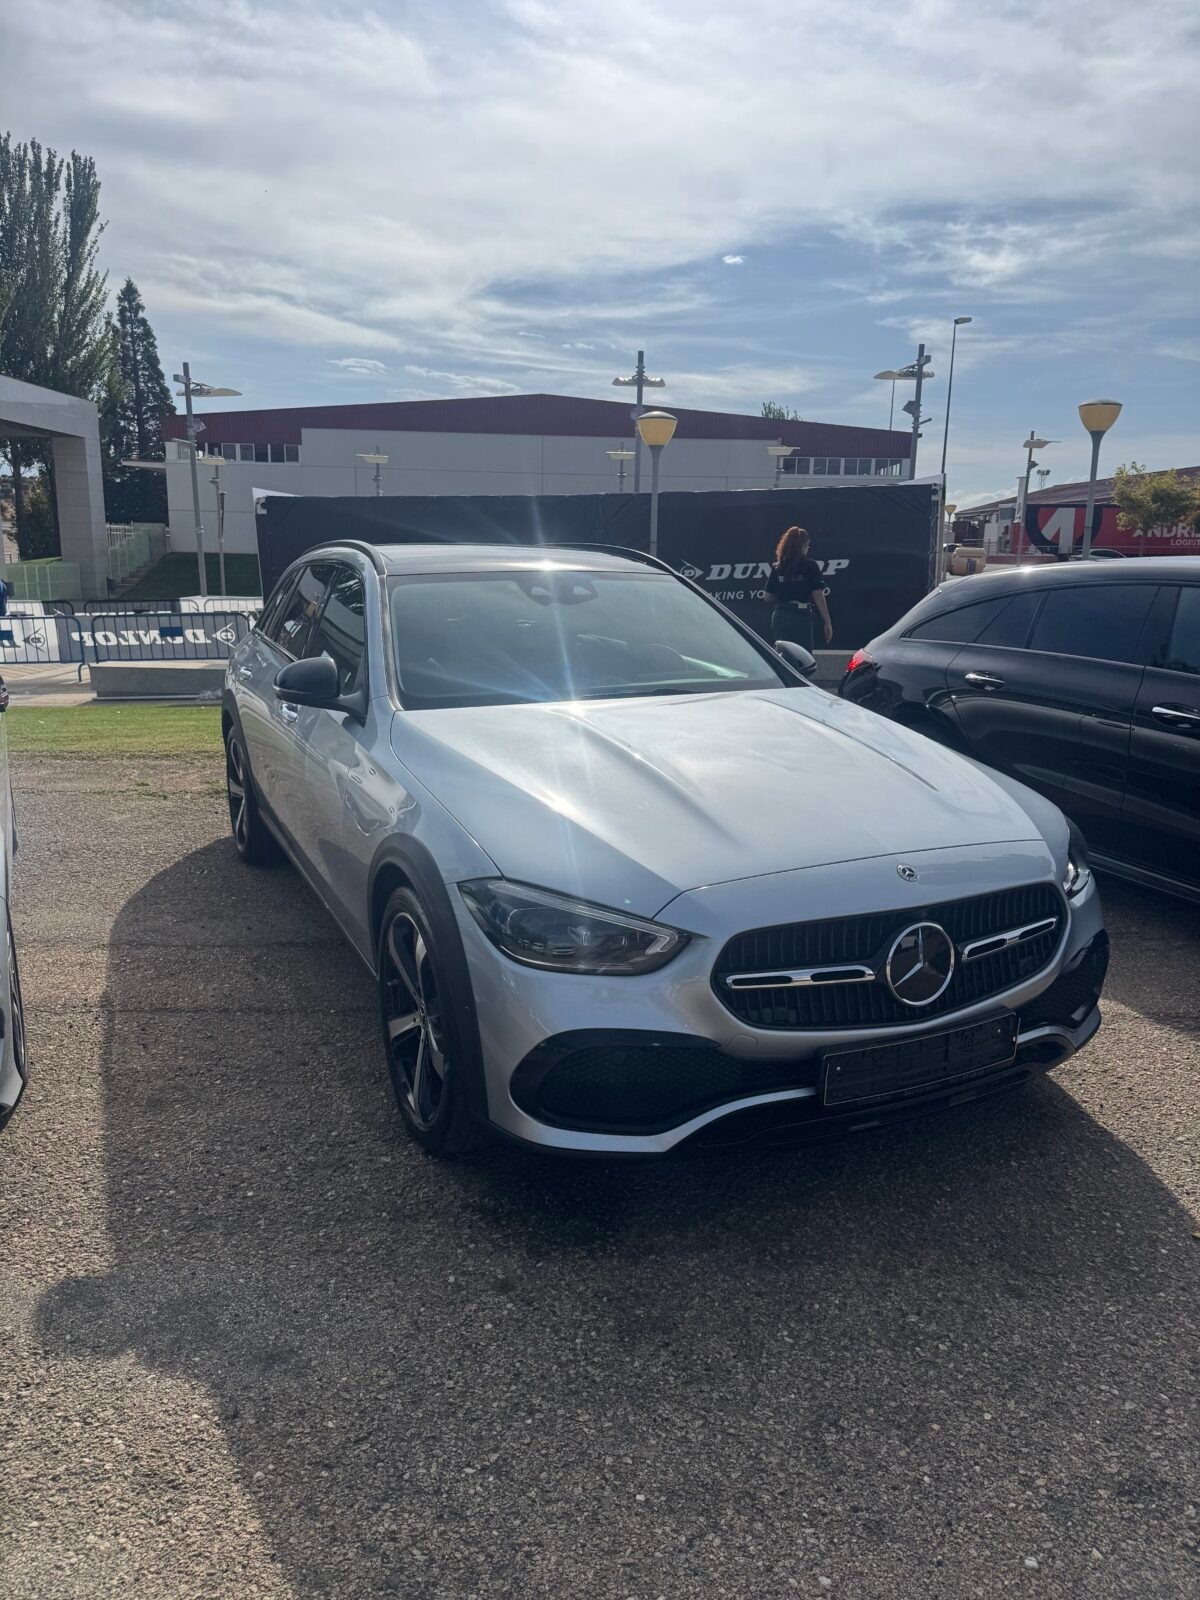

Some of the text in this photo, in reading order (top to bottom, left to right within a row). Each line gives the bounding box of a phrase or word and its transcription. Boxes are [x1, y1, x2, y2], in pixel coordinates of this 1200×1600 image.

[705, 559, 850, 580] DUNP
[708, 590, 766, 600] KING YO
